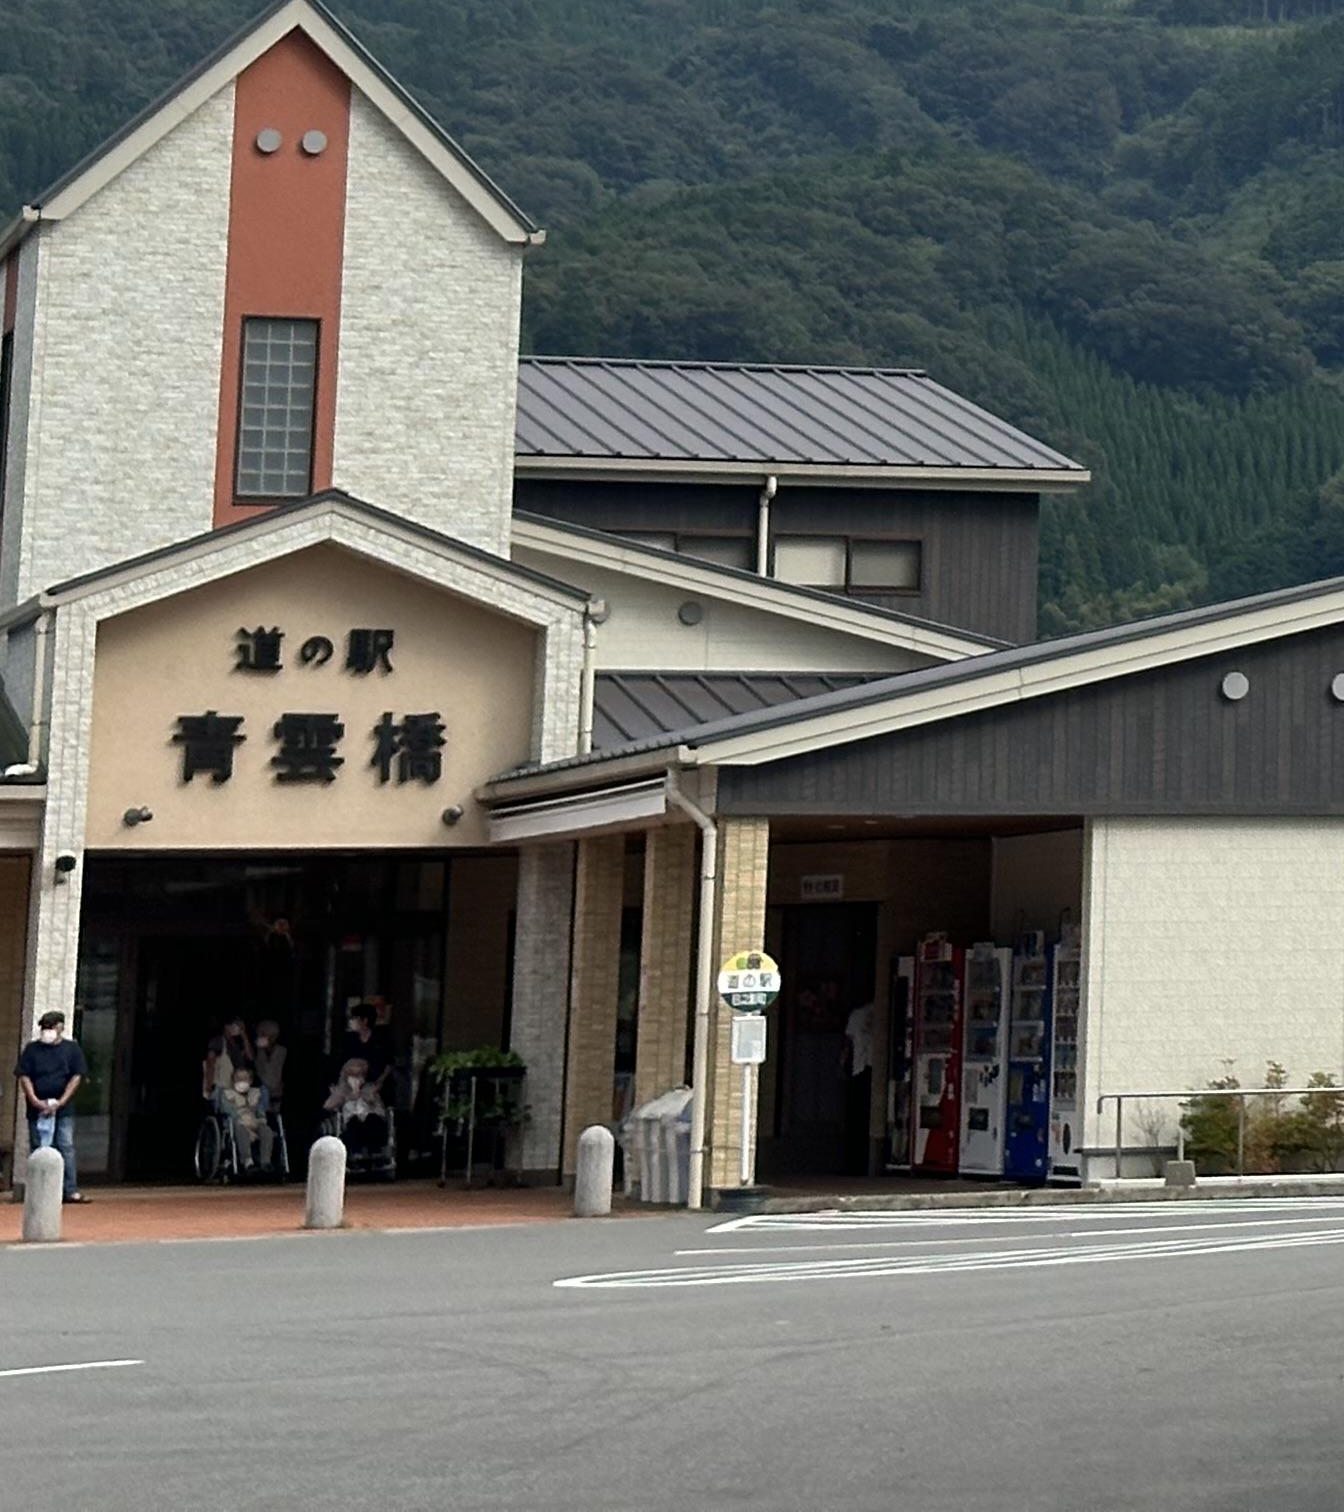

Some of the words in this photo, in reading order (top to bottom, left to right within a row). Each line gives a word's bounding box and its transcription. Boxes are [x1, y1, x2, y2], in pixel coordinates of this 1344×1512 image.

[234, 626, 395, 676] 道の駅
[171, 710, 447, 787] 青雲橋
